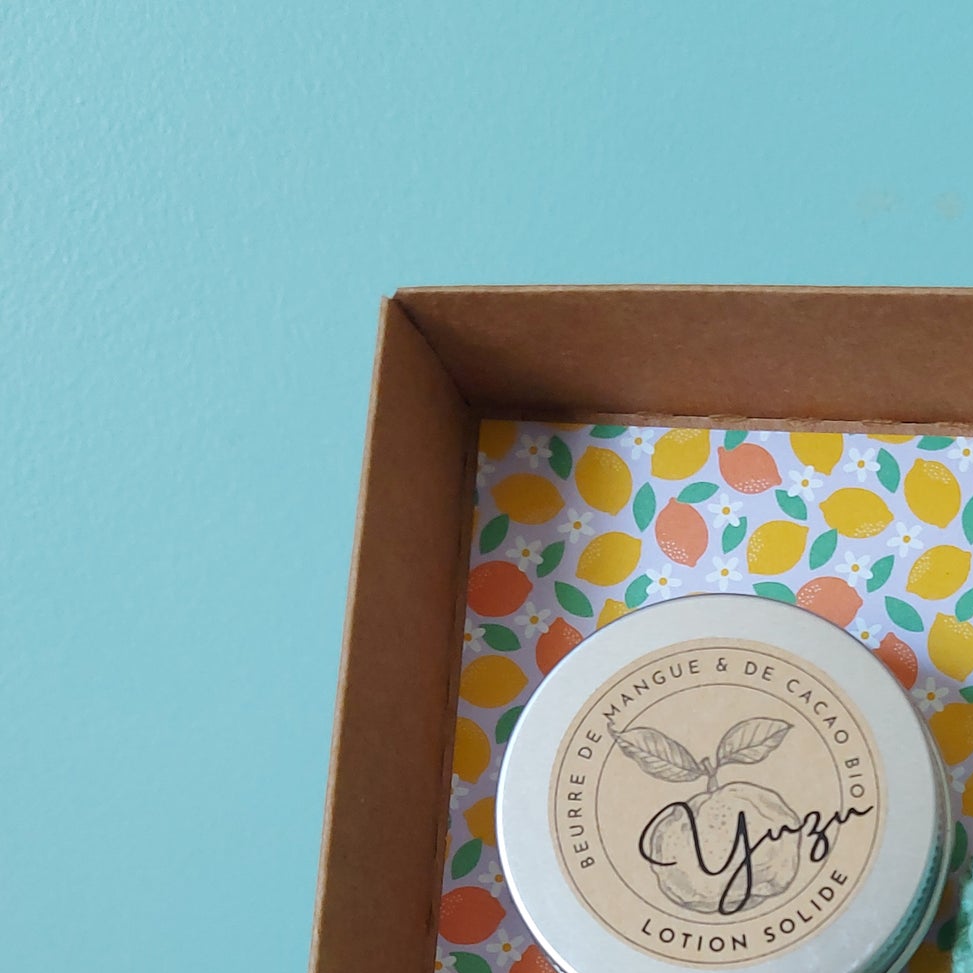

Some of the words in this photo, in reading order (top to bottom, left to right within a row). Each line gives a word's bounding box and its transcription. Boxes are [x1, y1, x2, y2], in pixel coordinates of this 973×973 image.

[602, 659, 701, 724] MANGUE
[715, 657, 729, 673] &
[744, 660, 775, 681] DE
[577, 728, 602, 760] DE
[785, 678, 850, 746] CACAO
[844, 756, 867, 800] BIO
[567, 772, 596, 869] BEURRE
[638, 801, 874, 916] Yuzu
[640, 916, 749, 953] LOTION
[763, 869, 848, 943] SOLIDE
